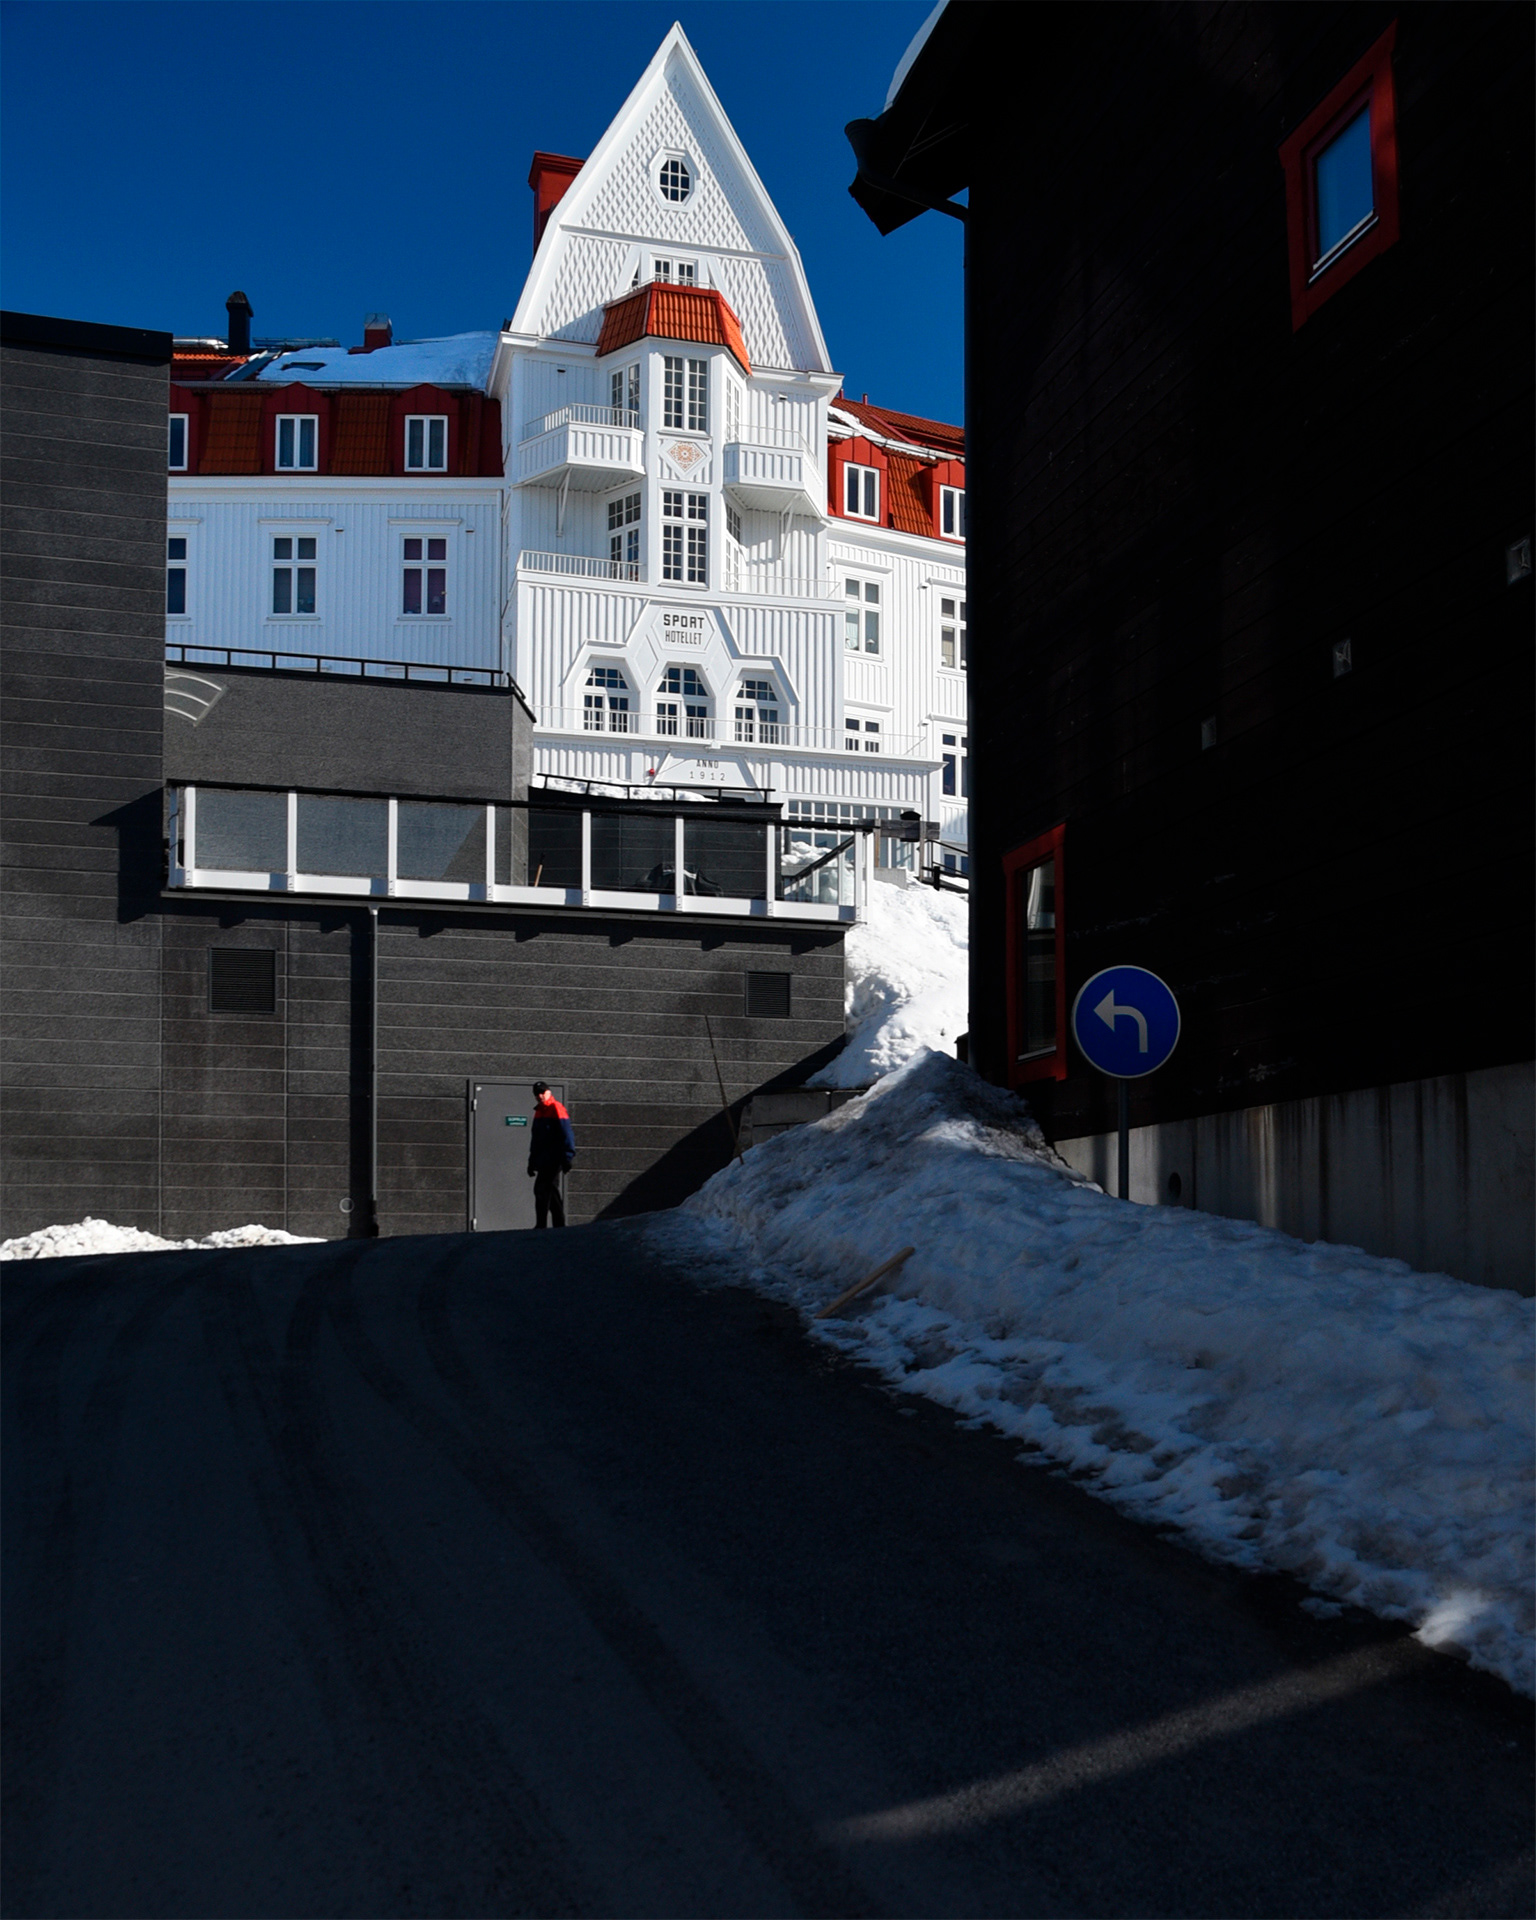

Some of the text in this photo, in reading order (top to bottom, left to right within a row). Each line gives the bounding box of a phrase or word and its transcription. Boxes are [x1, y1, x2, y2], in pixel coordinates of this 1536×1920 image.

[663, 613, 705, 629] SPORT
[665, 630, 702, 645] HOTELLET
[696, 759, 719, 769] ANNO
[689, 770, 725, 781] 1912
